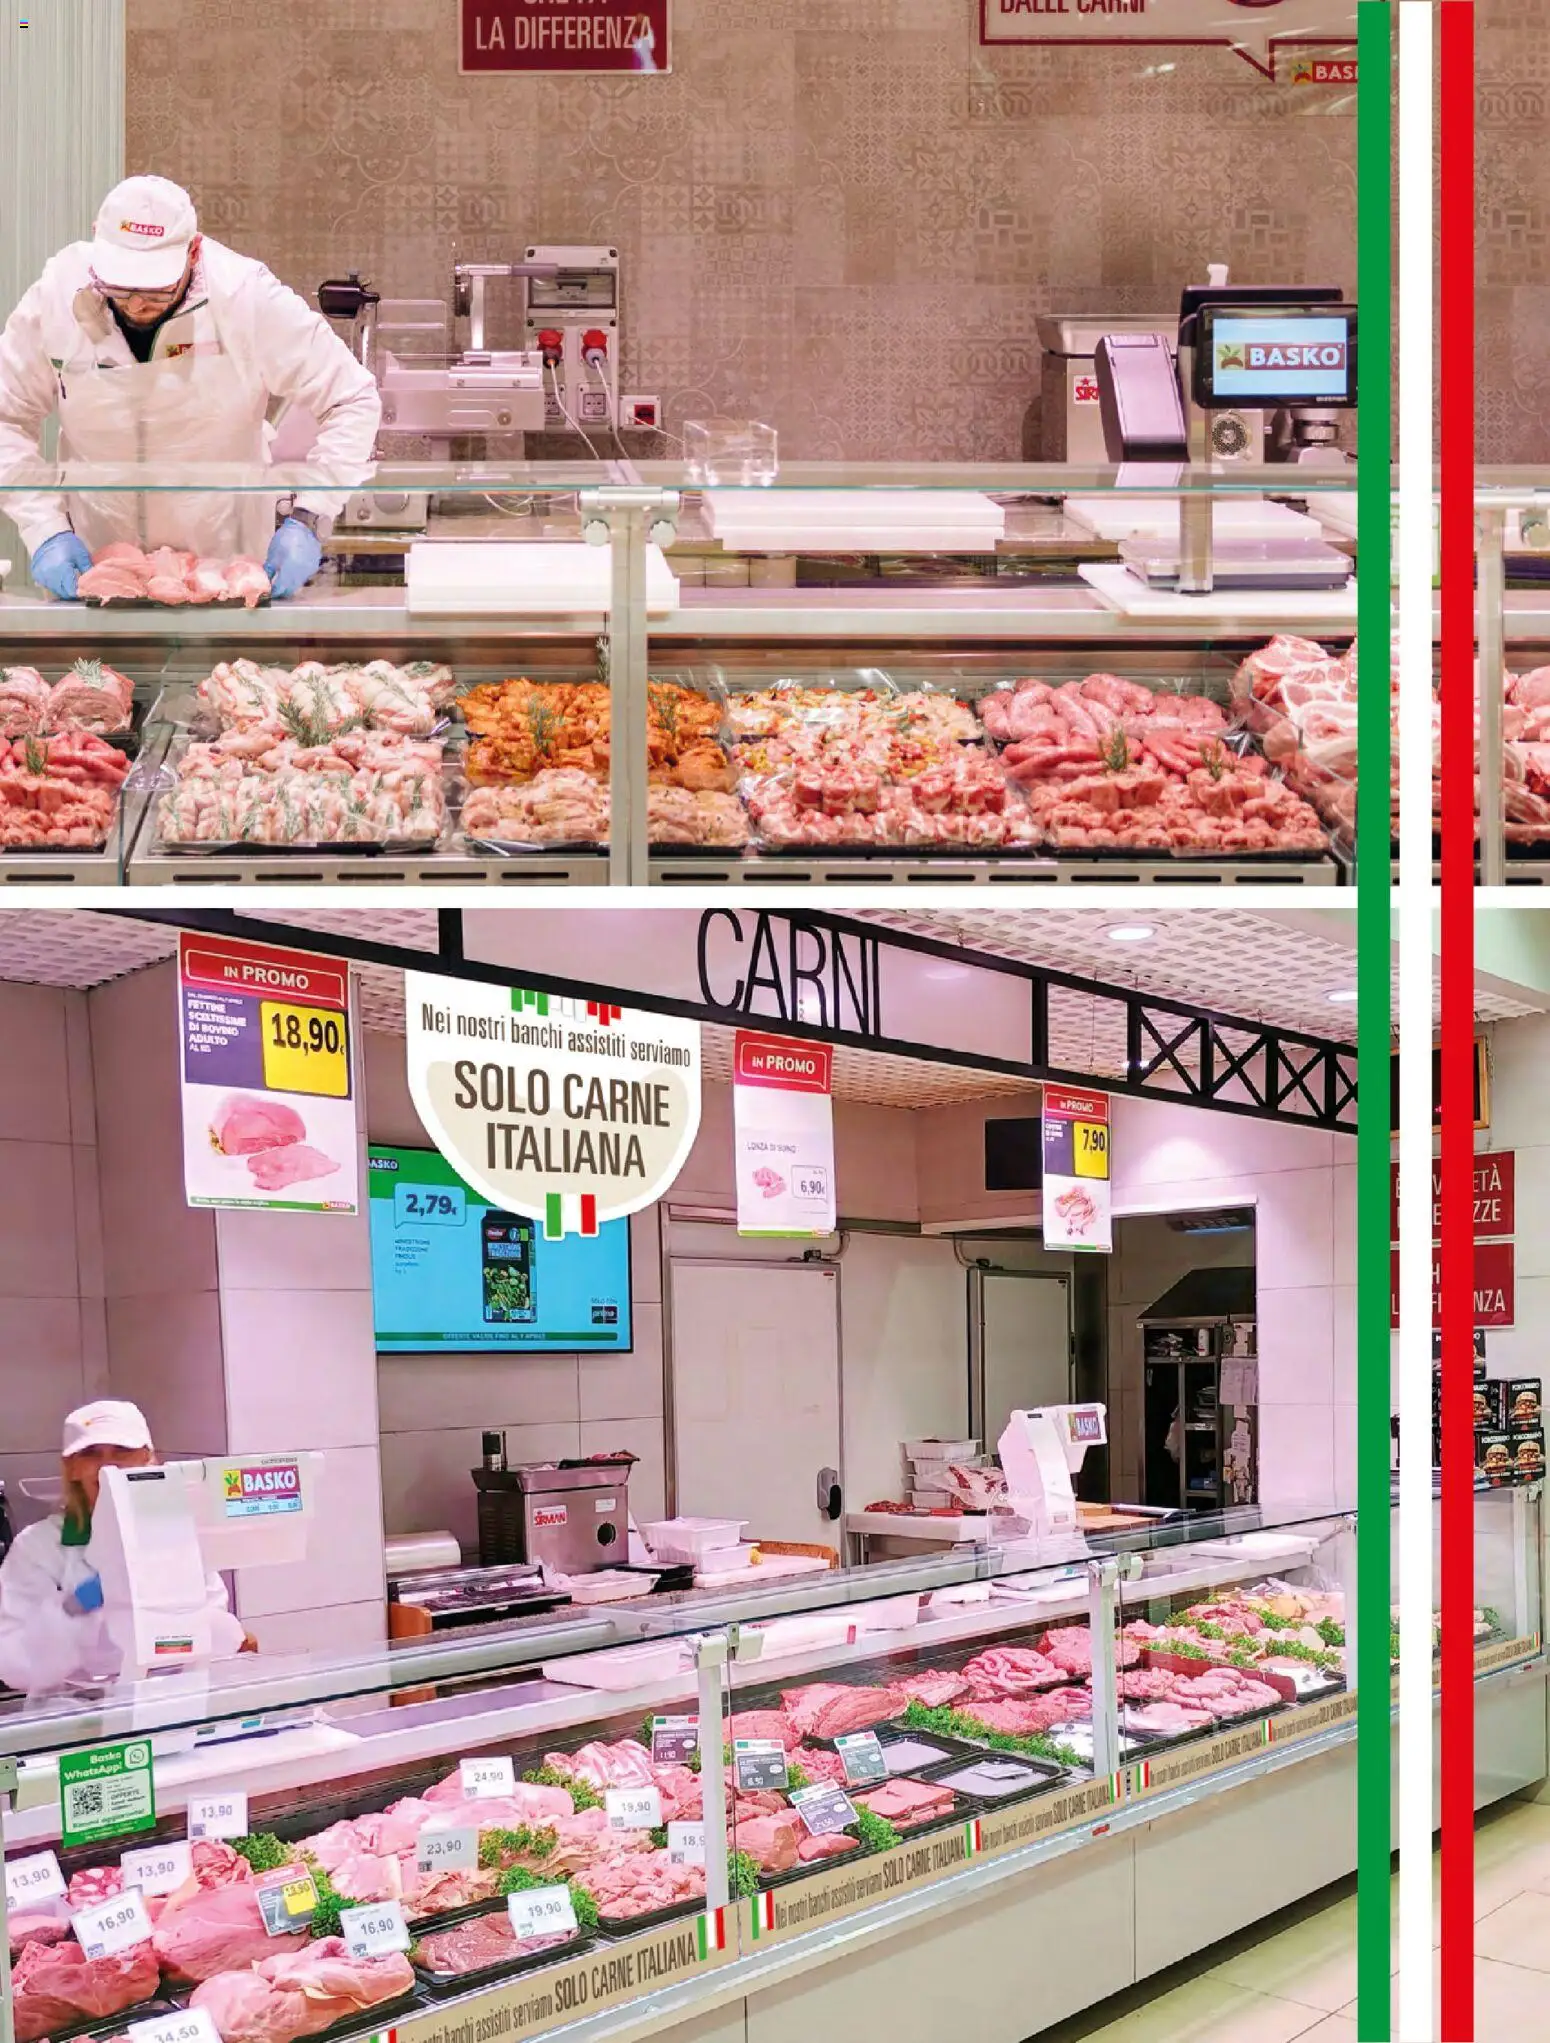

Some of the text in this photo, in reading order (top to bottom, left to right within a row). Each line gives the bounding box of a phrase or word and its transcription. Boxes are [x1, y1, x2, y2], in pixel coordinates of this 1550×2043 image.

[476, 16, 655, 50] LA DIFFERENZA
[130, 222, 164, 236] BASKO
[1250, 347, 1340, 367] BASKO
[224, 965, 309, 990] IN PROMO
[698, 908, 881, 1038] CARNI
[189, 1033, 229, 1046] ADULTO
[422, 1003, 691, 1067] Nei nostri banchi assistiti serviamo
[752, 1055, 816, 1075] IN PROMO
[454, 1060, 671, 1128] SOLO CARNE
[1066, 1099, 1094, 1113] PROMO
[487, 1122, 646, 1178] ITALIANA
[243, 1469, 296, 1492] BASKO
[12, 1868, 50, 1889] 13,90
[137, 1861, 175, 1880] 13,90
[775, 1900, 788, 1930] Nei
[788, 1893, 808, 1925] nostri
[808, 1884, 831, 1918] banchi
[882, 1861, 904, 1888] SOLO
[905, 1850, 931, 1880] CARNE
[932, 1835, 966, 1869] ITALIANA
[476, 2003, 511, 2042] assistiti
[513, 1993, 553, 2028] serviamo
[555, 1971, 587, 2013] SOLO
[591, 1959, 634, 2000] CARNE
[637, 1931, 696, 1983] ITALIANA
